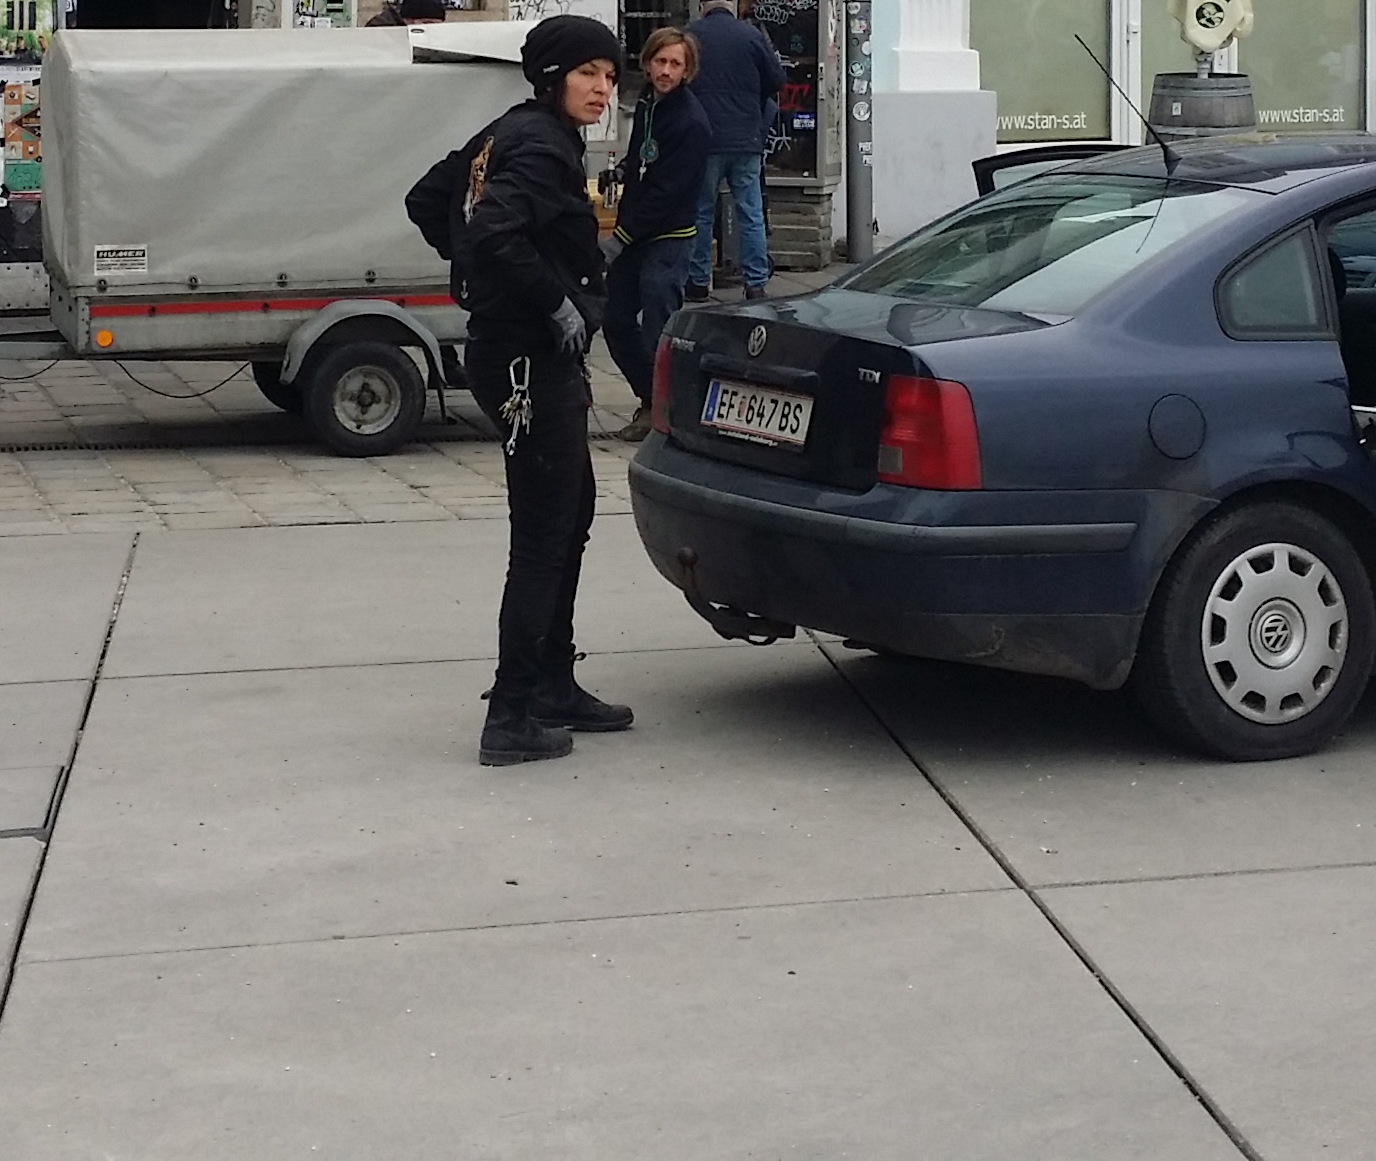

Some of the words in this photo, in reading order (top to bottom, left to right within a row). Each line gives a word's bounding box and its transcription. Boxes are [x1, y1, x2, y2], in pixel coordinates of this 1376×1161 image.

[1258, 106, 1345, 124] www.stan-s.at
[857, 367, 882, 384] TDI
[716, 388, 739, 421] EF
[745, 394, 779, 429] 647
[778, 401, 804, 435] BS
